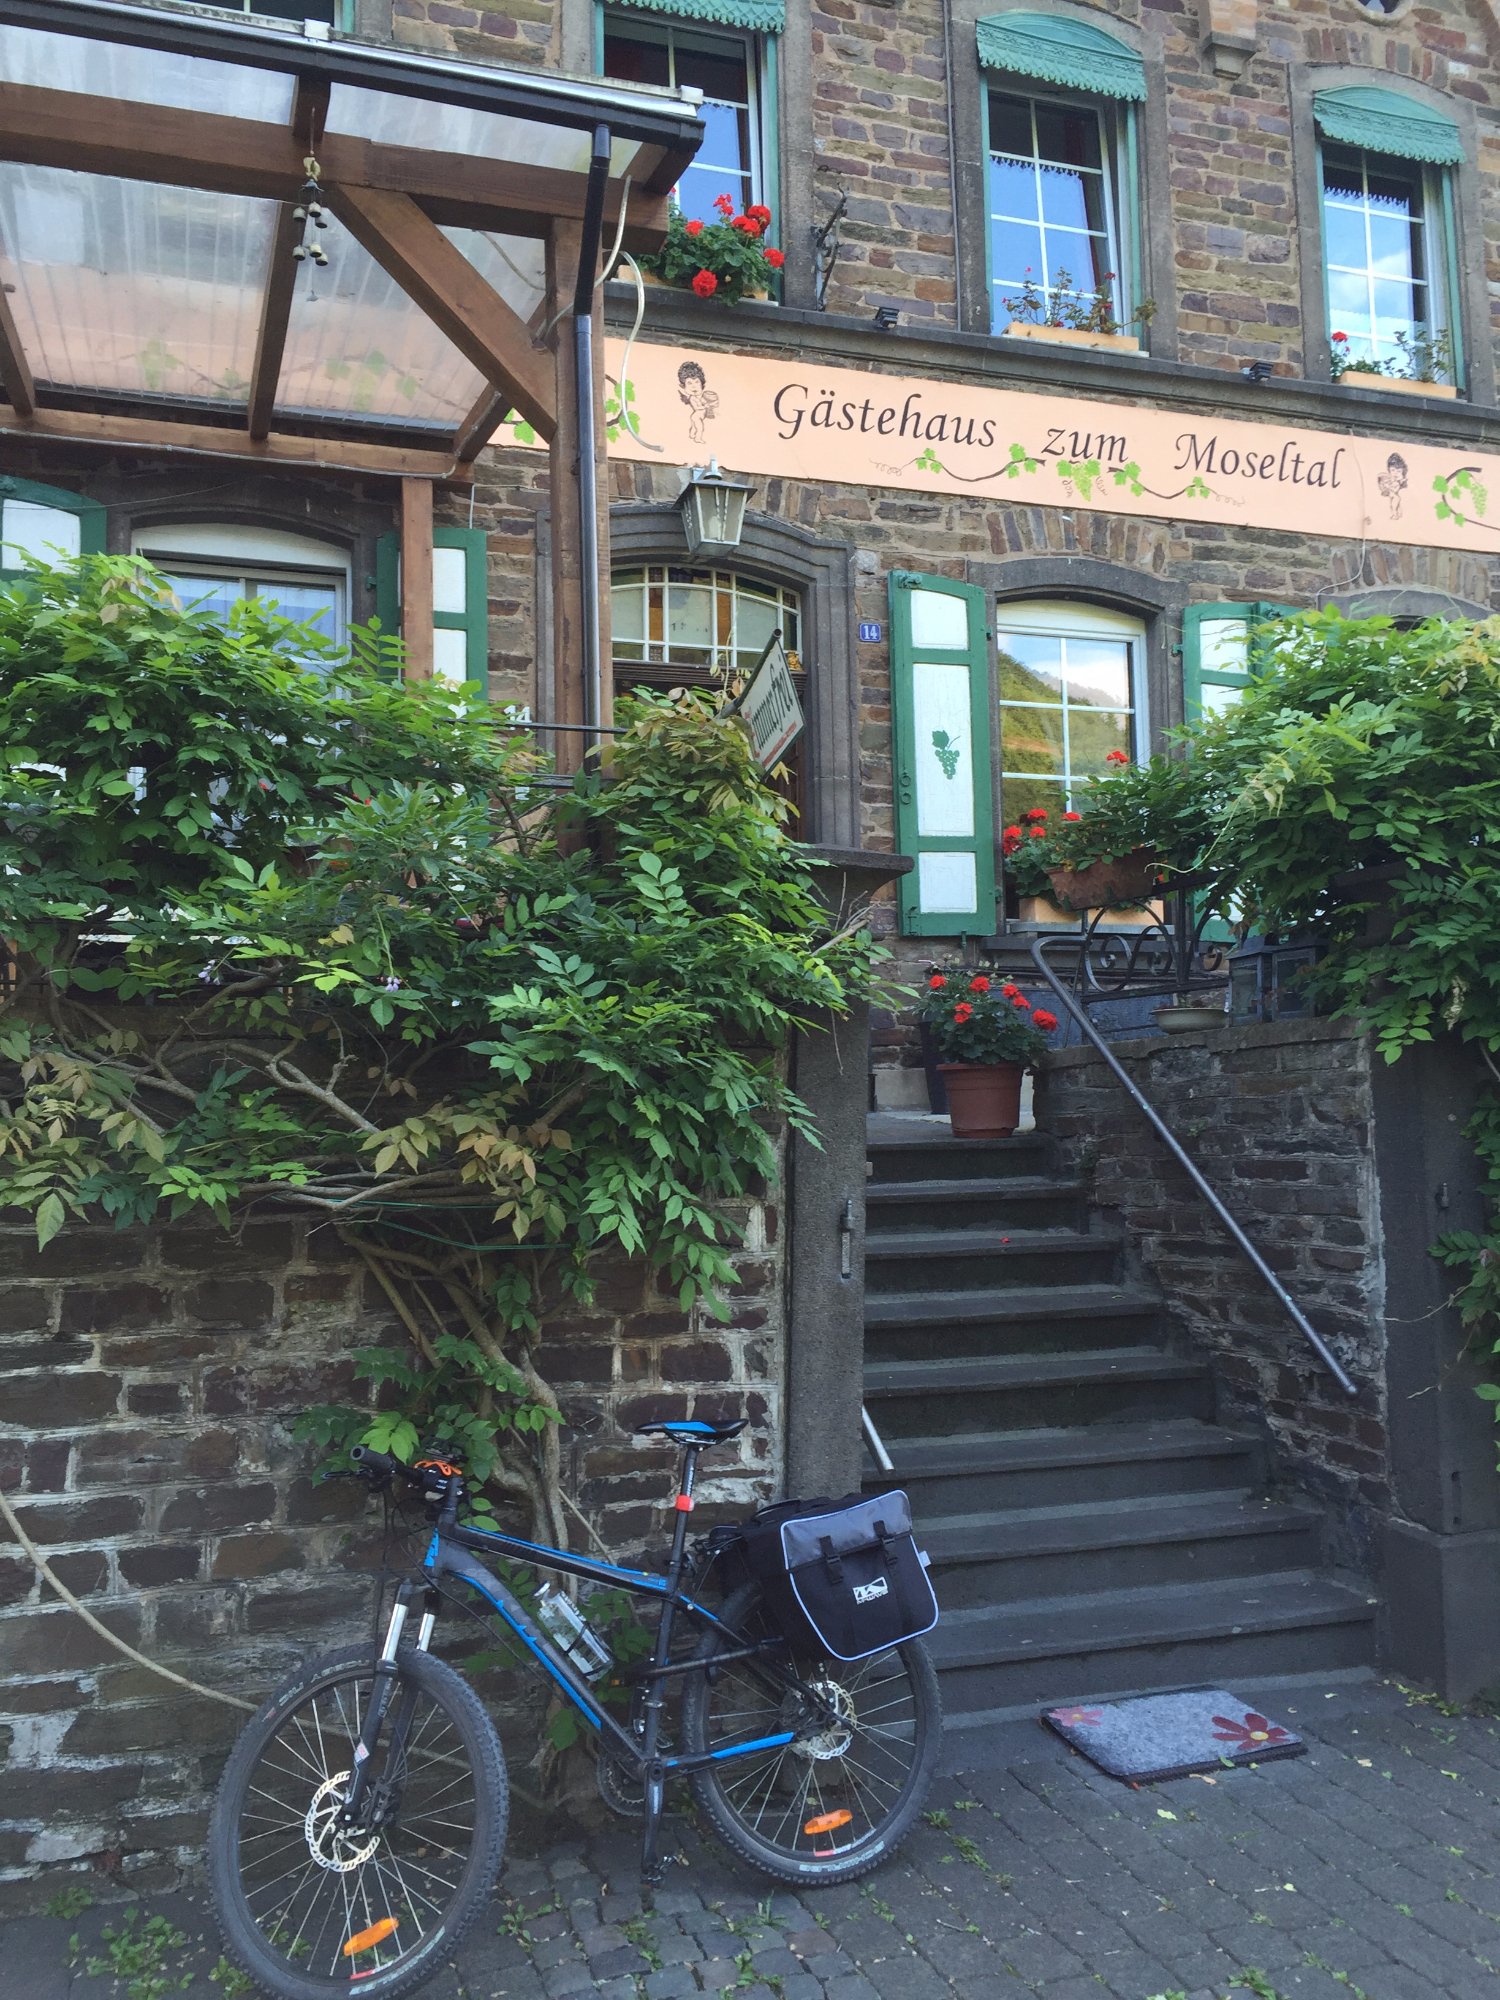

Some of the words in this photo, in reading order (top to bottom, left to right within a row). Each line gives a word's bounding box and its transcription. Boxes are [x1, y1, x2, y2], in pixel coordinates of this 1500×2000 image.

[773, 382, 997, 448] Gästehaus
[1040, 428, 1128, 464] zum
[1173, 432, 1346, 490] Moseltal
[864, 625, 878, 640] 14
[503, 705, 532, 732] 14
